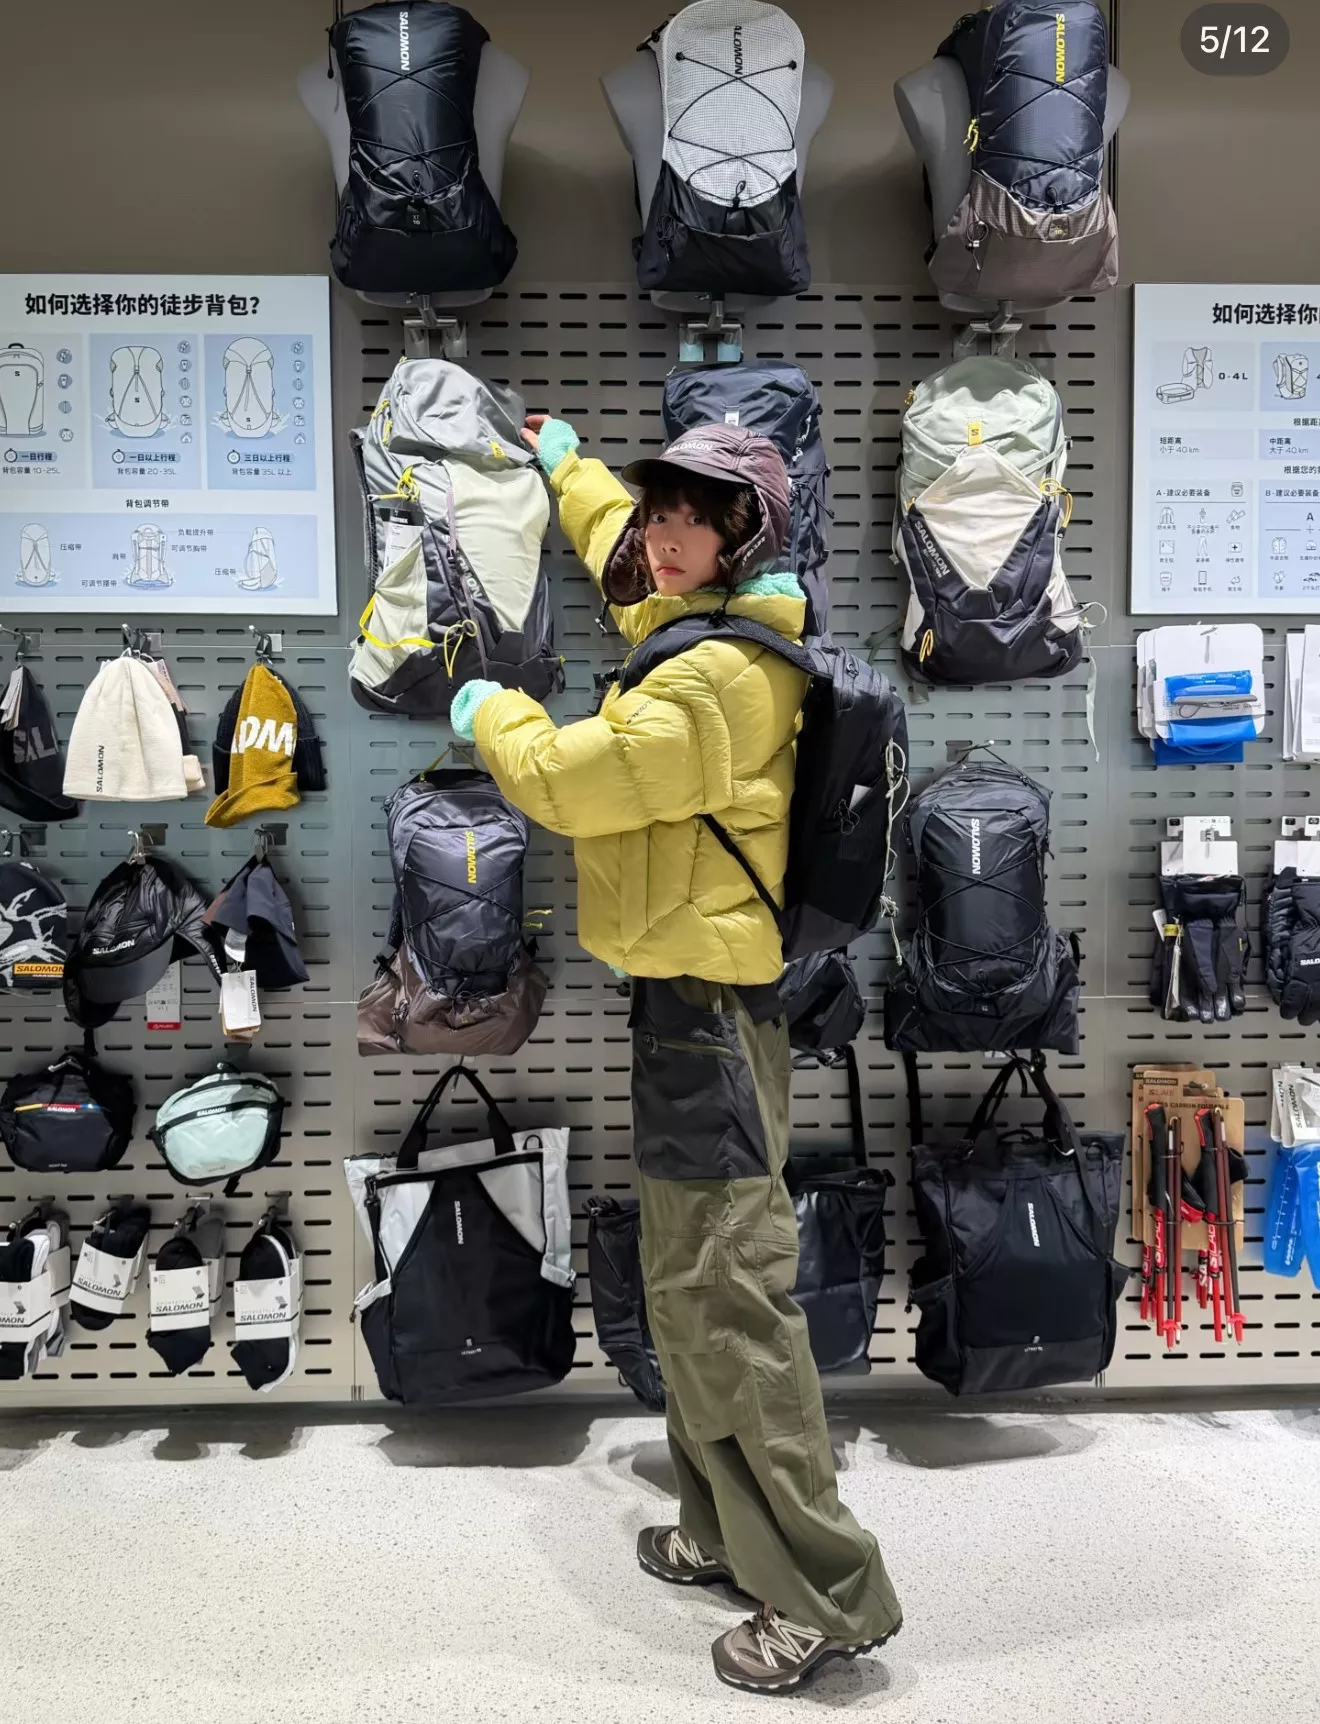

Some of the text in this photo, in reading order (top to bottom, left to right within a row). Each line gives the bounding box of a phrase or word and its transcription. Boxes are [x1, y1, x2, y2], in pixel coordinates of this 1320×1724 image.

[400, 11, 410, 71] SALOMON
[1055, 13, 1065, 83] SALOMON
[734, 25, 743, 75] ALOMON
[1212, 303, 1320, 325] 如何选择你
[1293, 418, 1320, 427] 根据距
[1160, 437, 1182, 445] 短距离
[1269, 437, 1291, 445] 中距离
[21, 453, 53, 461] 一日行程
[129, 453, 176, 462] 一日以上行程
[243, 453, 291, 463] 三日以上行程
[2, 466, 31, 475] 背包容量
[117, 467, 146, 476] 背包容量
[231, 468, 260, 476] 背包容量
[126, 499, 169, 508] 背包调节带
[915, 521, 951, 576] SALOMON
[96, 745, 105, 793] SALOMON
[971, 819, 981, 875] SALOMON
[466, 831, 476, 883] SALOMON
[93, 939, 135, 955] SALOMON
[250, 976, 258, 1012] SALOMON
[197, 1107, 227, 1117] SALOMON
[1288, 1084, 1303, 1128] SALOMON
[454, 1201, 464, 1245] SALOMON
[1028, 1203, 1040, 1247] SALOMON
[78, 1277, 121, 1296] SALOMON
[156, 1302, 204, 1312] SALOMON
[240, 1312, 287, 1322] SALOMON
